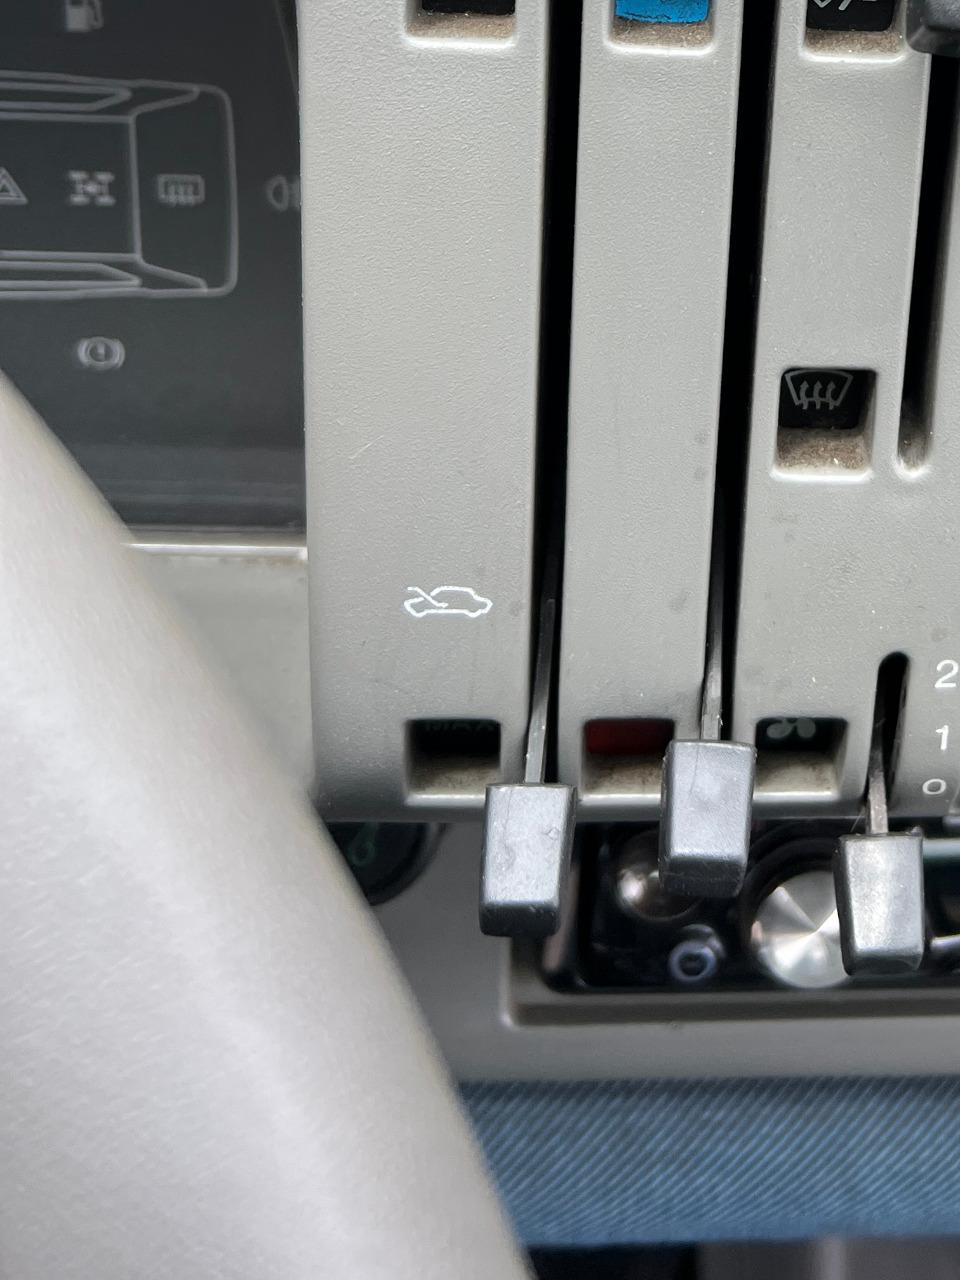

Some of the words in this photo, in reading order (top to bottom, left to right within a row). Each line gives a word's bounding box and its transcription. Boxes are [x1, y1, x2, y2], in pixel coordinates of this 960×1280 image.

[934, 659, 959, 689] 2
[935, 724, 950, 751] 1
[922, 778, 947, 795] 0
